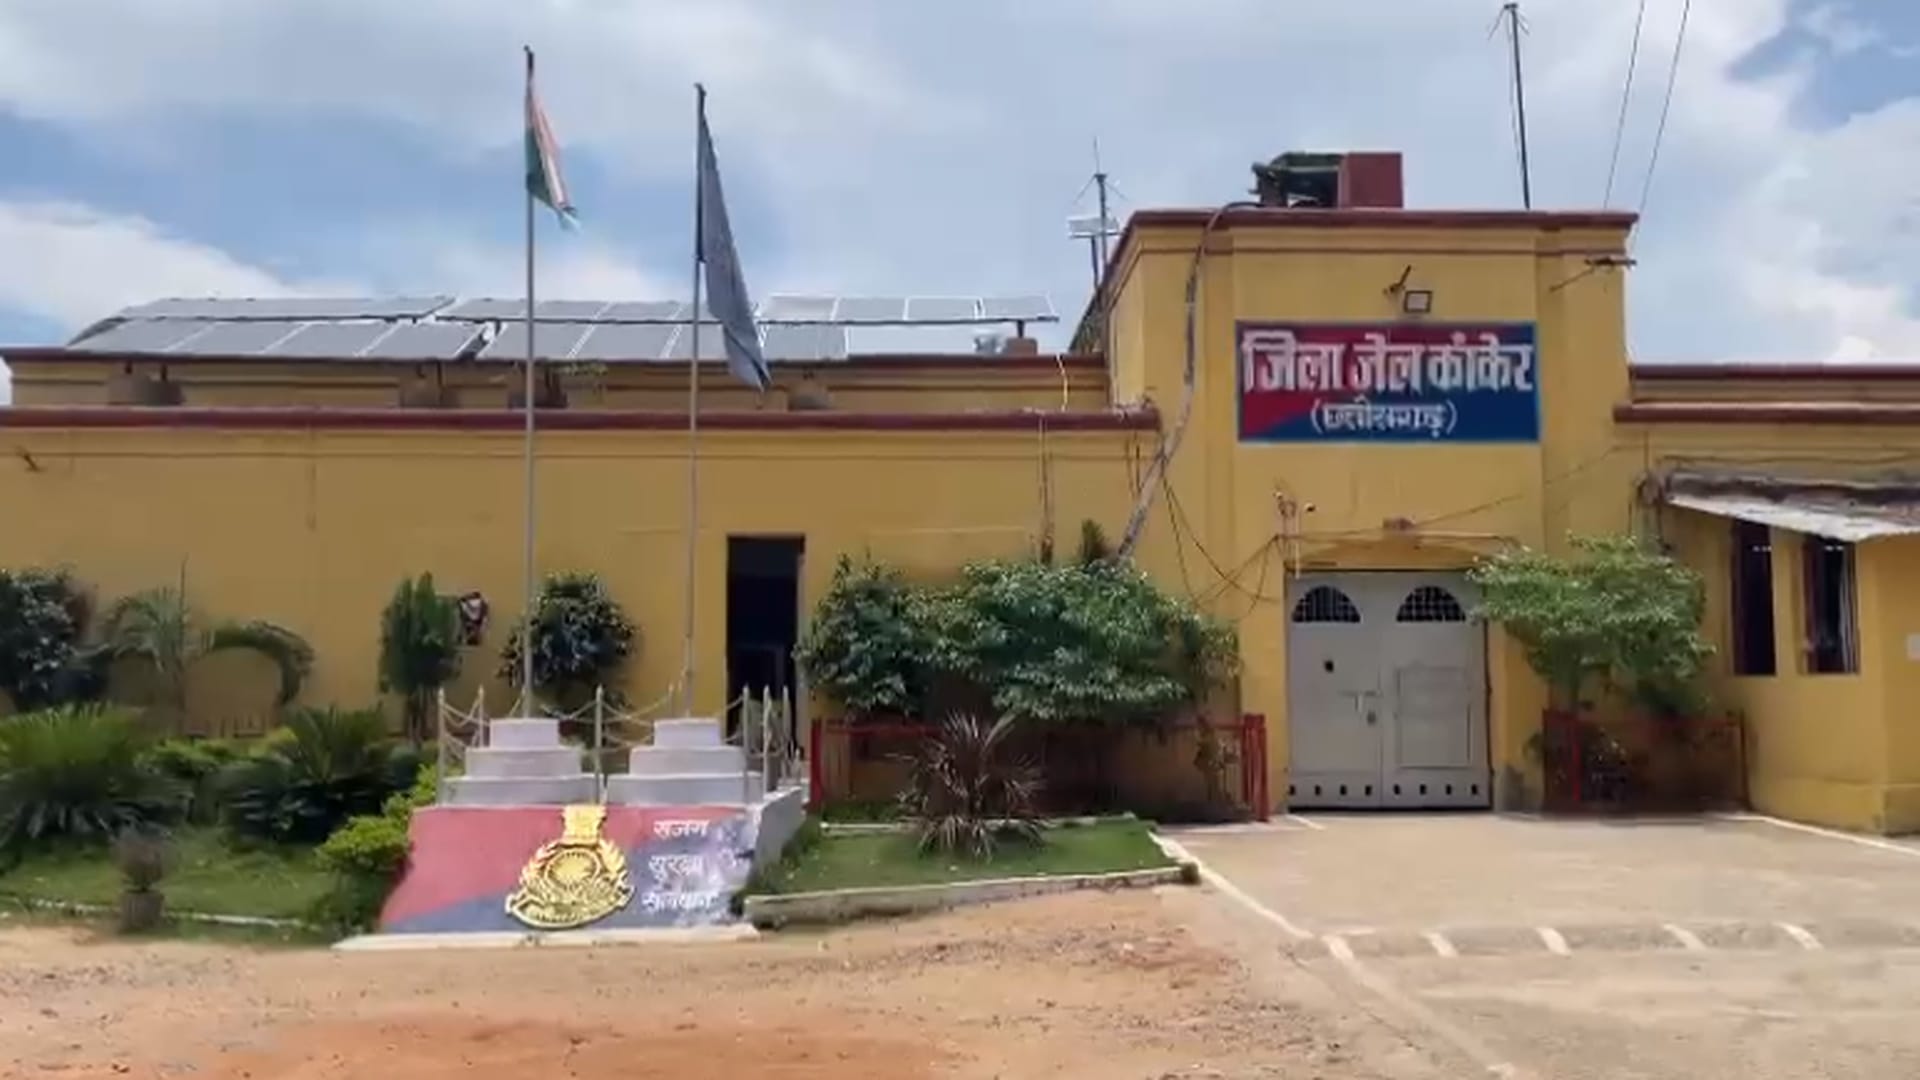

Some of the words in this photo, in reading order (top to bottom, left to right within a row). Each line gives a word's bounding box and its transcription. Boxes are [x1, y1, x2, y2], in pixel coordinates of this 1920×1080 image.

[1242, 330, 1345, 392] जिला
[1350, 332, 1423, 392] जेल
[1429, 331, 1533, 391] कांकेर
[653, 819, 710, 839] सजग
